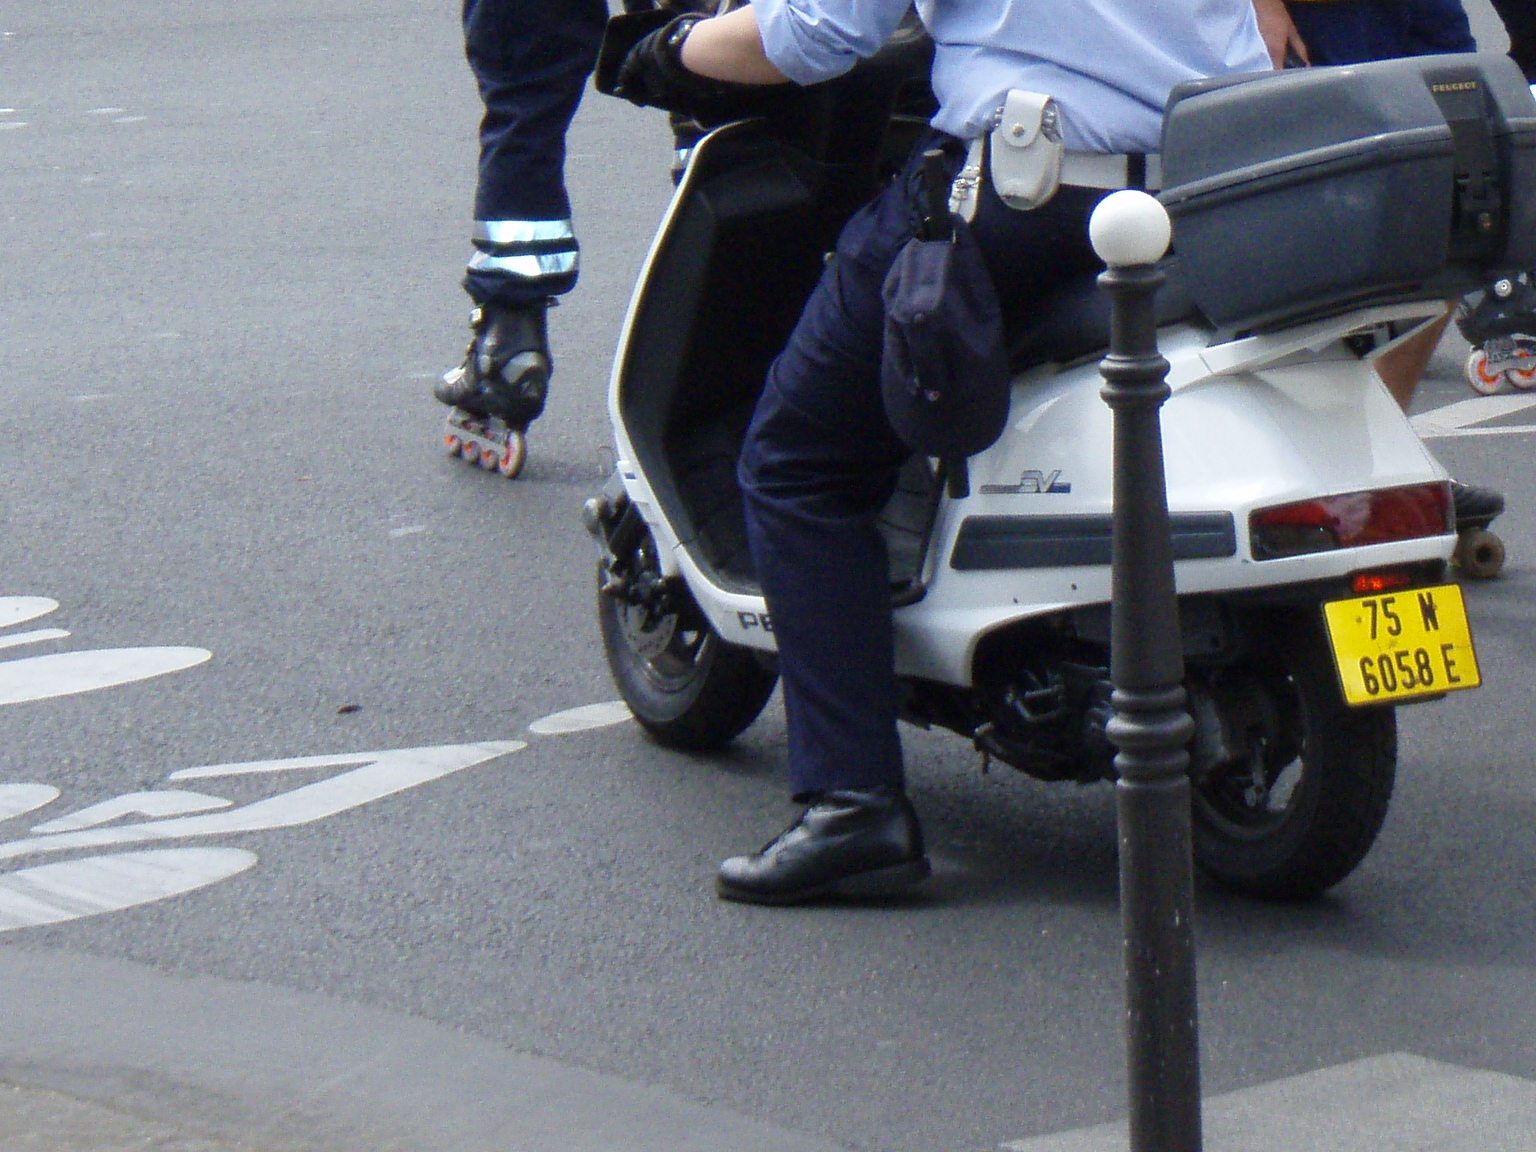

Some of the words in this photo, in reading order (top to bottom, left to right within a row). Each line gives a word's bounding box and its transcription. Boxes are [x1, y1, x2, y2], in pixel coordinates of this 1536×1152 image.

[1362, 596, 1402, 640] 75
[1417, 591, 1440, 632] N
[1359, 648, 1434, 695] 6058
[1440, 642, 1461, 684] E
